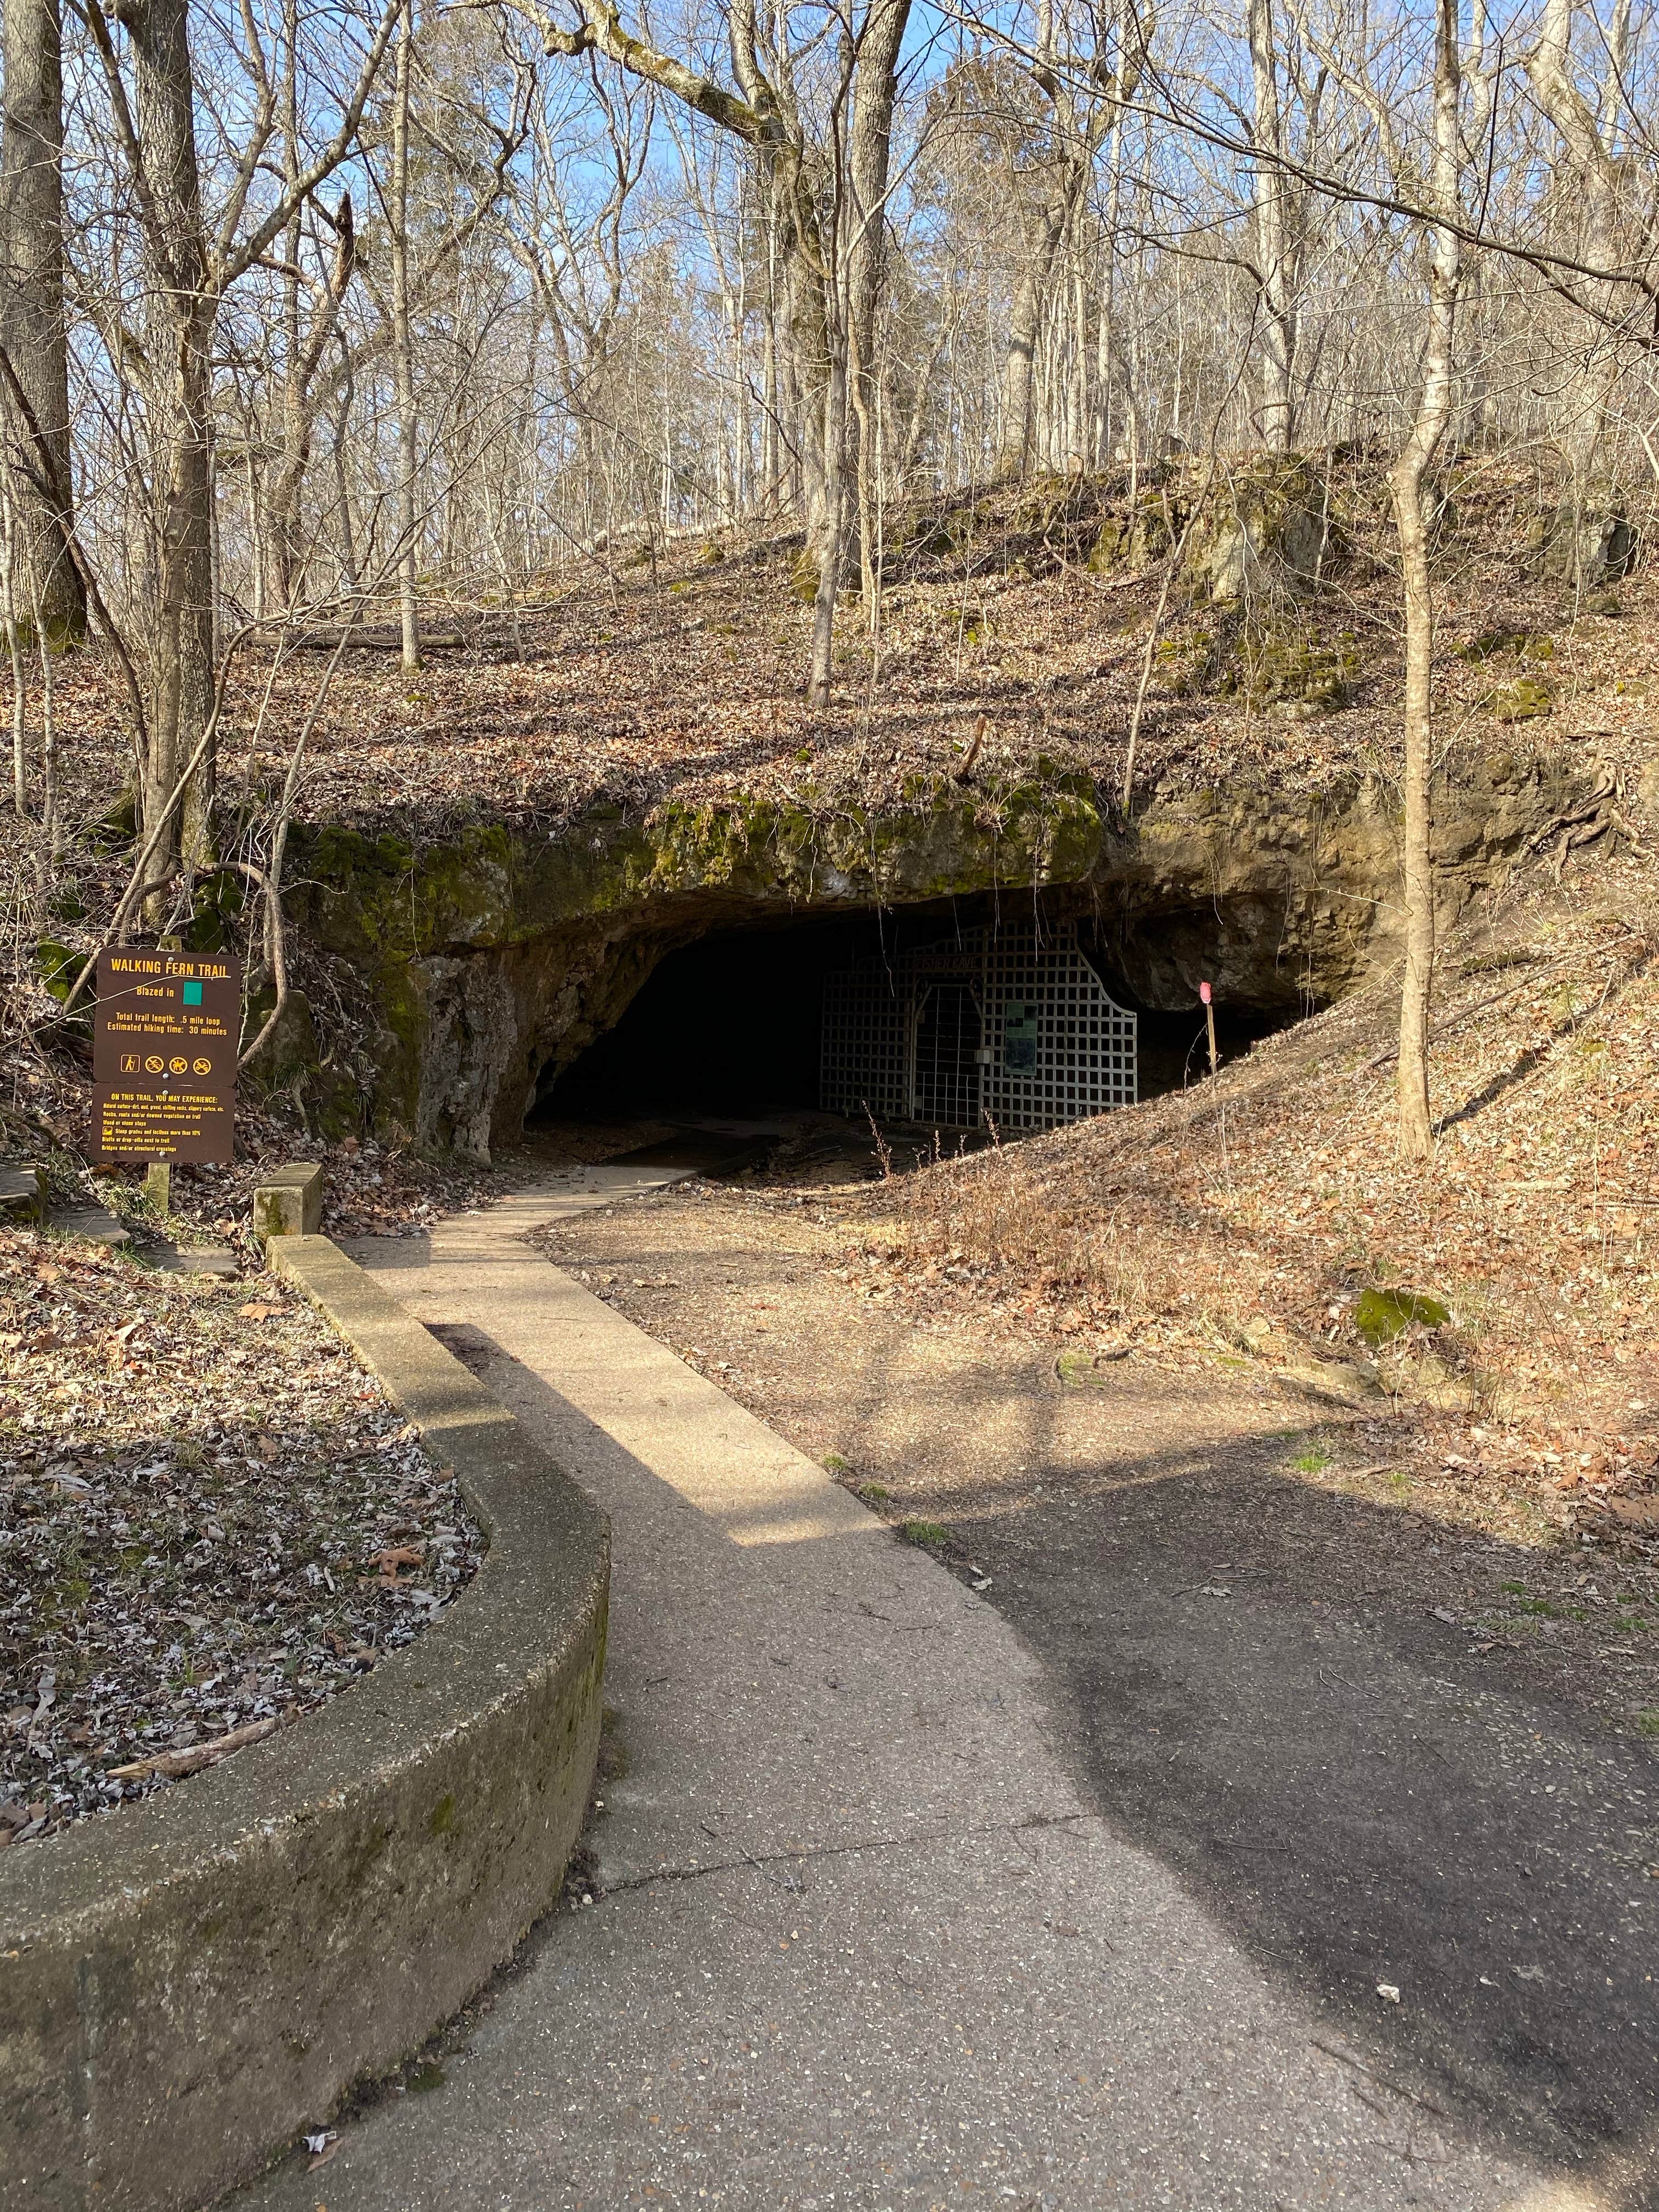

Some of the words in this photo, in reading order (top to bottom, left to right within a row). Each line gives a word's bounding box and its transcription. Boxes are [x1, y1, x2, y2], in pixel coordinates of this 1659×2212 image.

[111, 958, 160, 973] WALKING
[166, 962, 194, 976] FERN
[198, 964, 228, 977] TRAIL
[952, 957, 979, 969] CAVE
[137, 986, 163, 996] Blazed
[167, 988, 174, 997] in
[116, 1012, 132, 1021] Total
[152, 1015, 175, 1024] length:
[190, 1016, 204, 1024] mile
[206, 1017, 220, 1025] loop
[108, 1022, 141, 1031] Estimated
[144, 1023, 164, 1034] hiking
[167, 1025, 184, 1034] time:
[189, 1026, 198, 1034] 30
[201, 1026, 227, 1035] minutes
